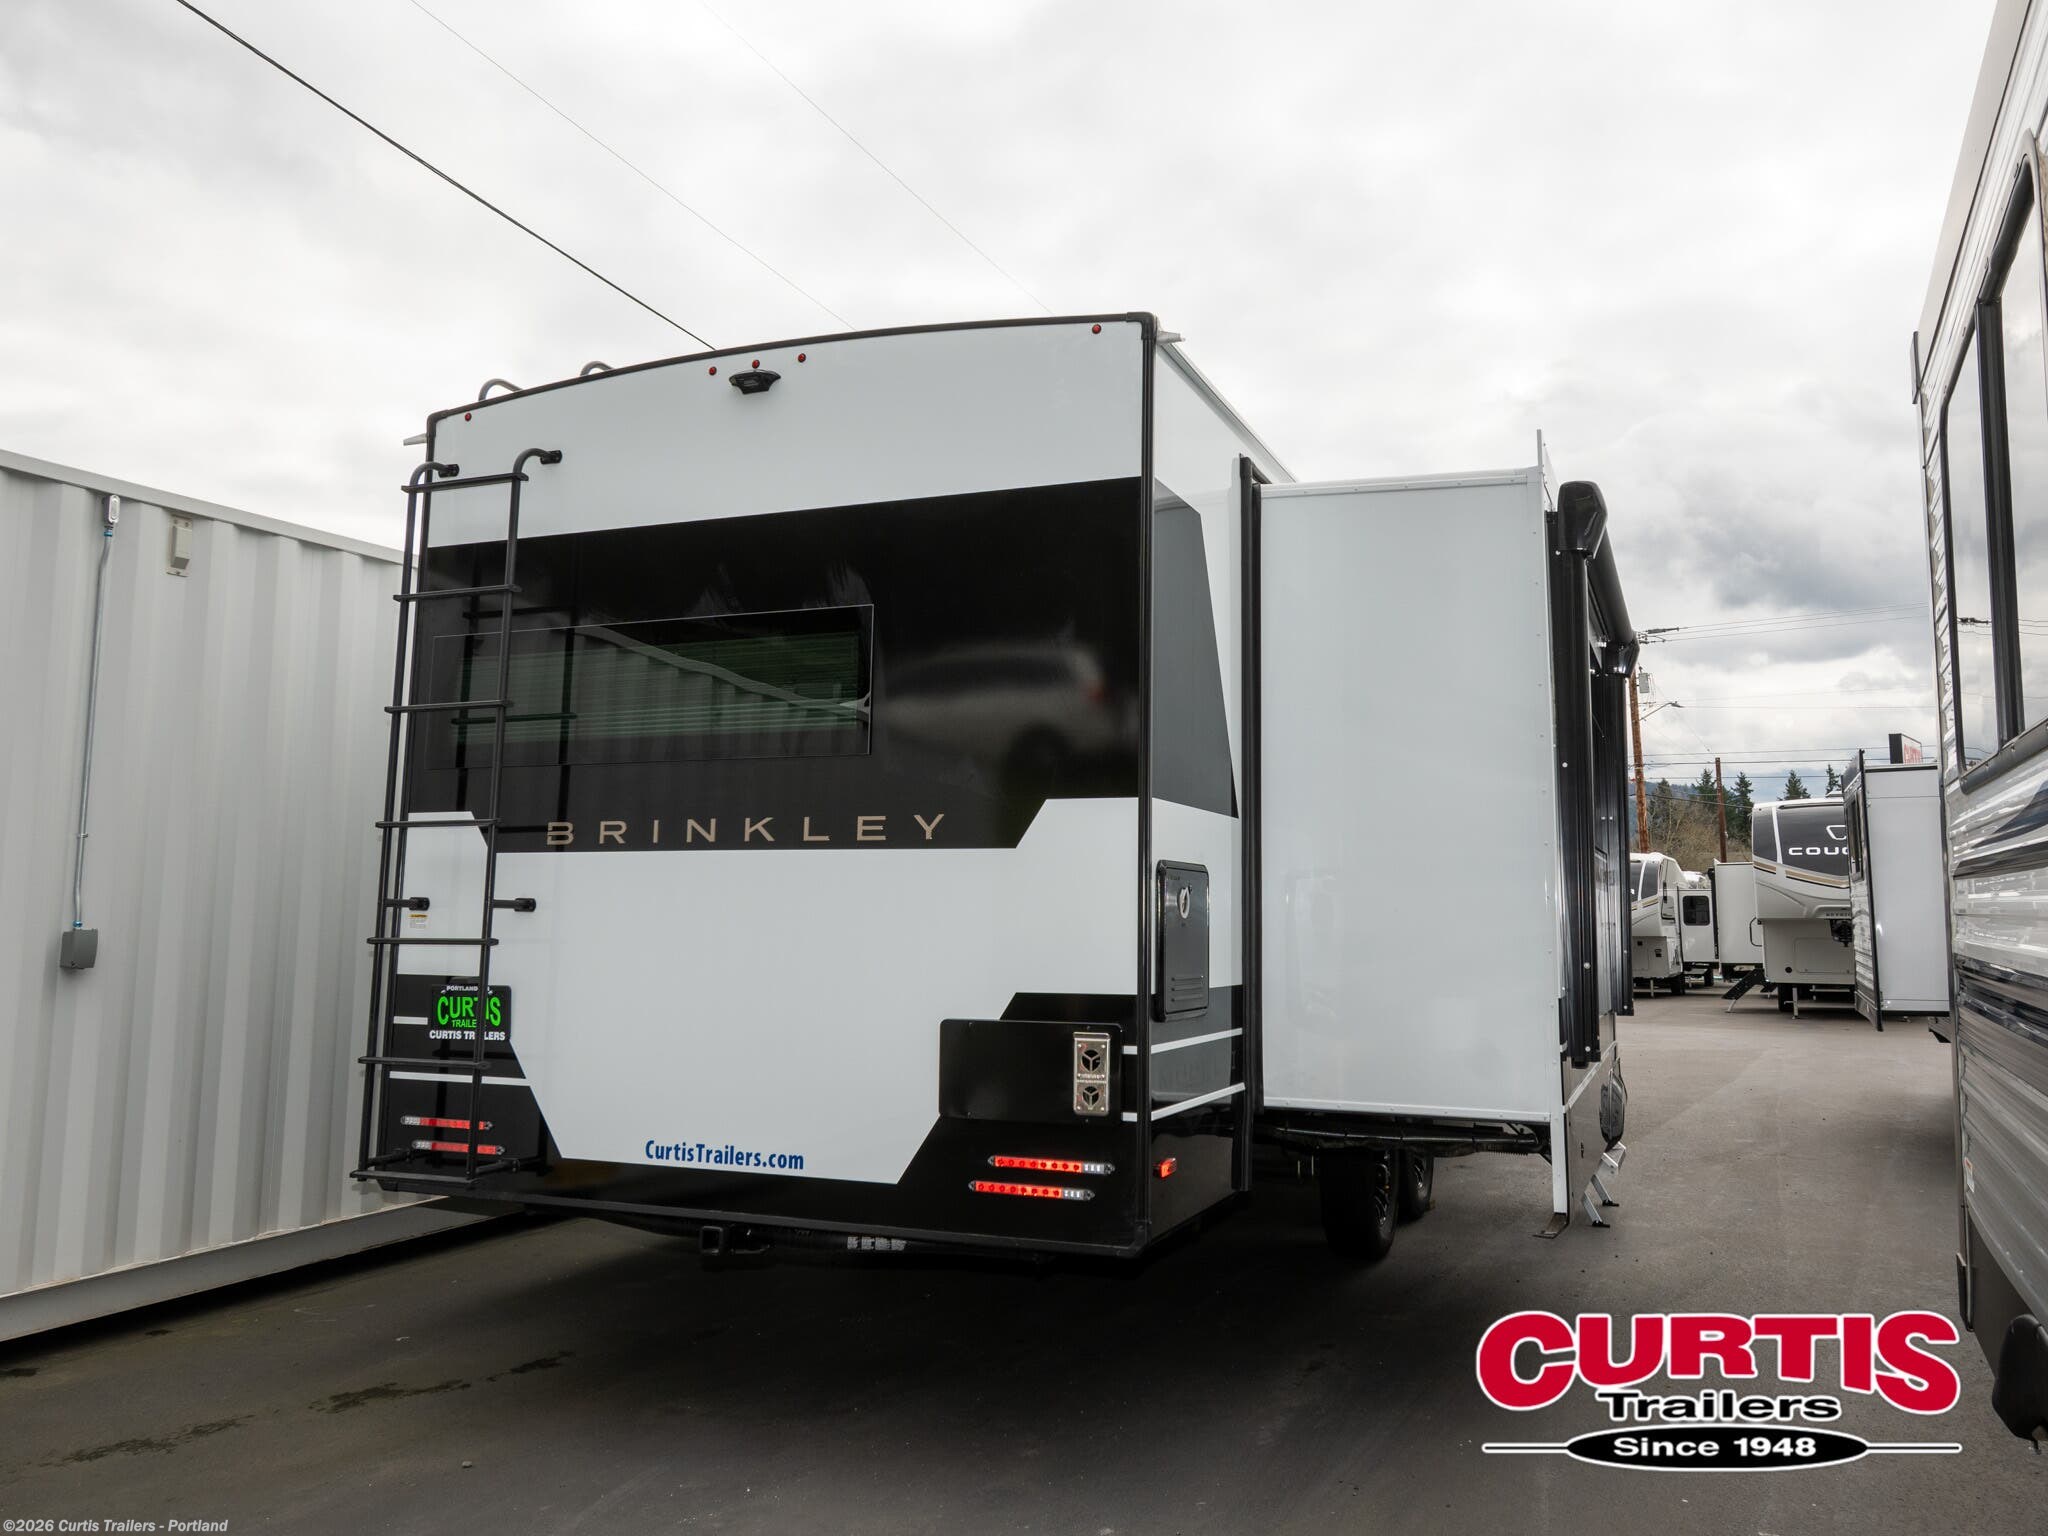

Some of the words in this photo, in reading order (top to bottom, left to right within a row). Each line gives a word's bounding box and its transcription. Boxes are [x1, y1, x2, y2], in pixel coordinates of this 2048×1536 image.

[546, 813, 945, 846] BRINKLEY
[429, 1030, 462, 1040] CURTIS
[463, 1031, 506, 1041] TRLERS
[645, 1140, 804, 1170] CurtisTrailers.com
